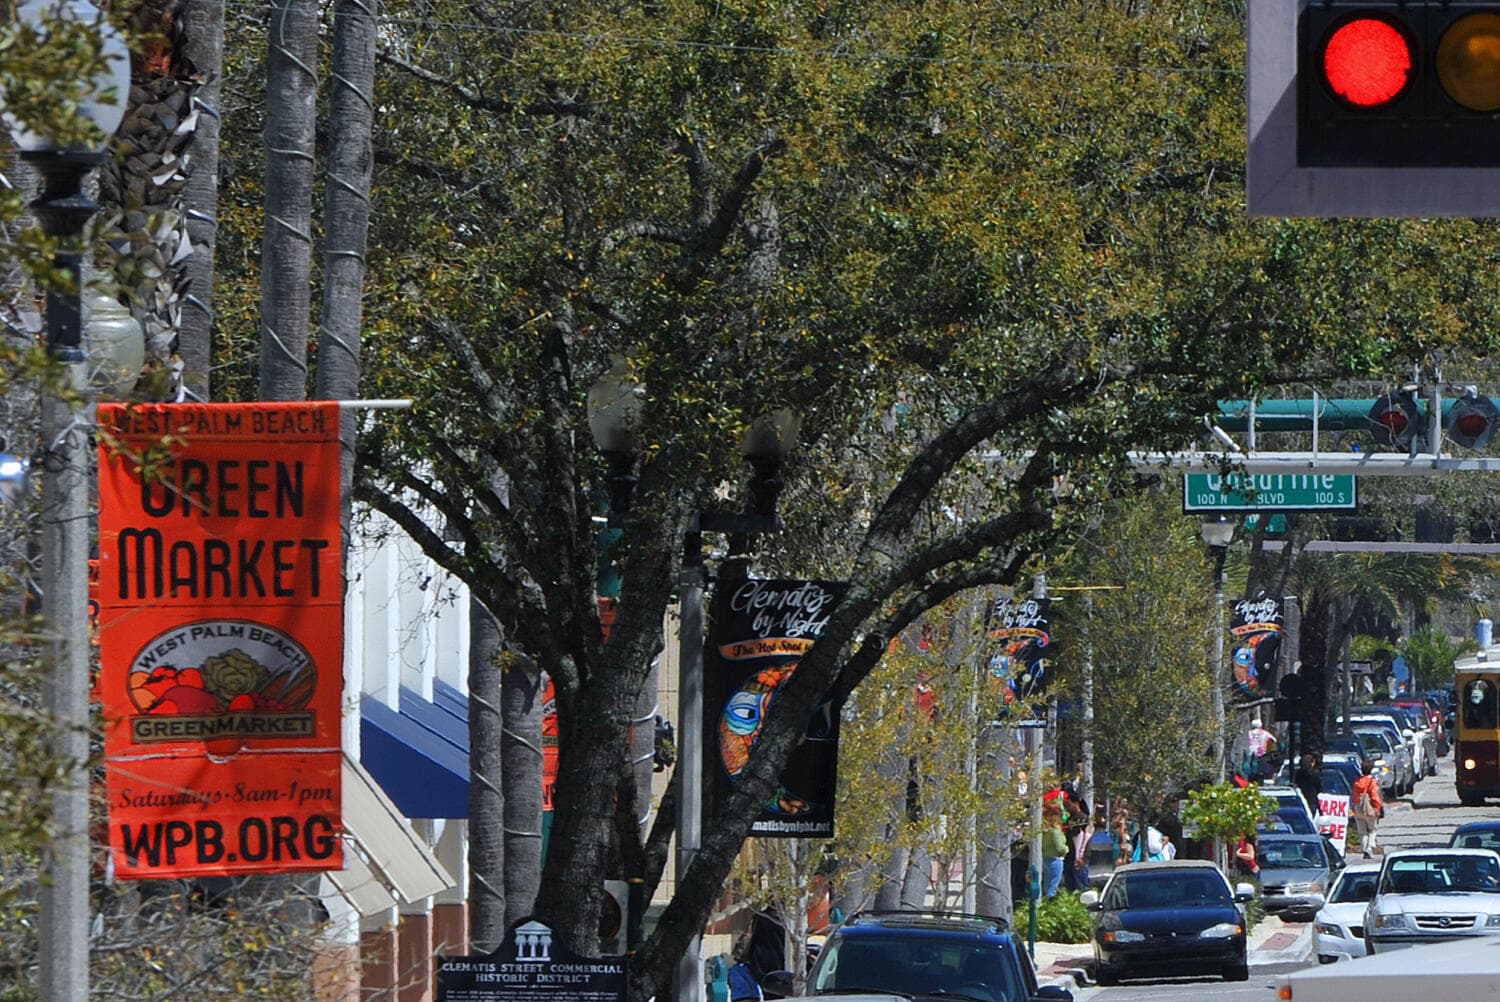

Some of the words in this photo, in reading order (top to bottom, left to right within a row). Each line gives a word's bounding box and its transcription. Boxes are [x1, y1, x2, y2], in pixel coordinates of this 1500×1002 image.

[253, 410, 325, 433] BEACH
[1197, 494, 1215, 505] 100
[1315, 493, 1333, 504] 100
[1338, 493, 1345, 503] S
[118, 527, 329, 599] MARKET
[730, 581, 834, 614] Clematis
[752, 608, 777, 638] by
[780, 608, 830, 637] Night
[139, 633, 187, 670] WEST
[192, 626, 244, 641] PALM
[250, 628, 307, 668] BEACH
[732, 645, 754, 656] The
[135, 716, 312, 737] GREENMARKET
[121, 815, 335, 868] WPB.ORG
[442, 963, 496, 973] CLEMATIS
[500, 963, 544, 973] STREET
[550, 964, 623, 974] COMMERCIAL
[475, 973, 529, 983] HISTORIC
[536, 974, 591, 983] DISTRICT
